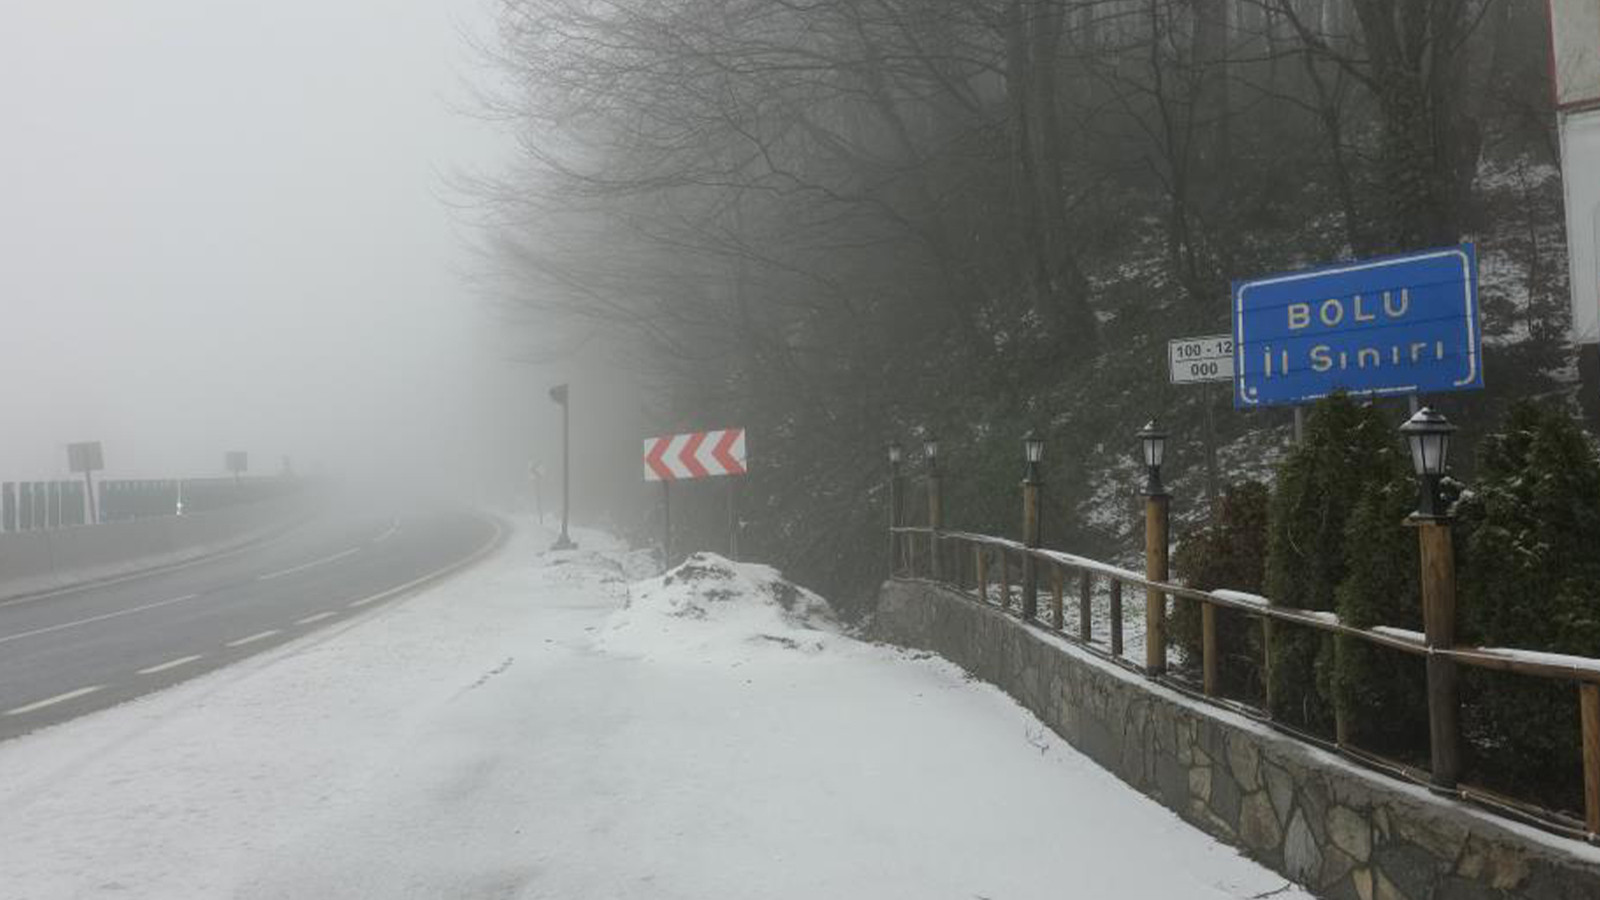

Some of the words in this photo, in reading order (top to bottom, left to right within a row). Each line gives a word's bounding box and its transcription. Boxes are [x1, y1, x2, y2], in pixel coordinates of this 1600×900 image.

[1287, 288, 1409, 330] BOLU
[1177, 344, 1201, 358] 100
[1191, 362, 1218, 376] 000
